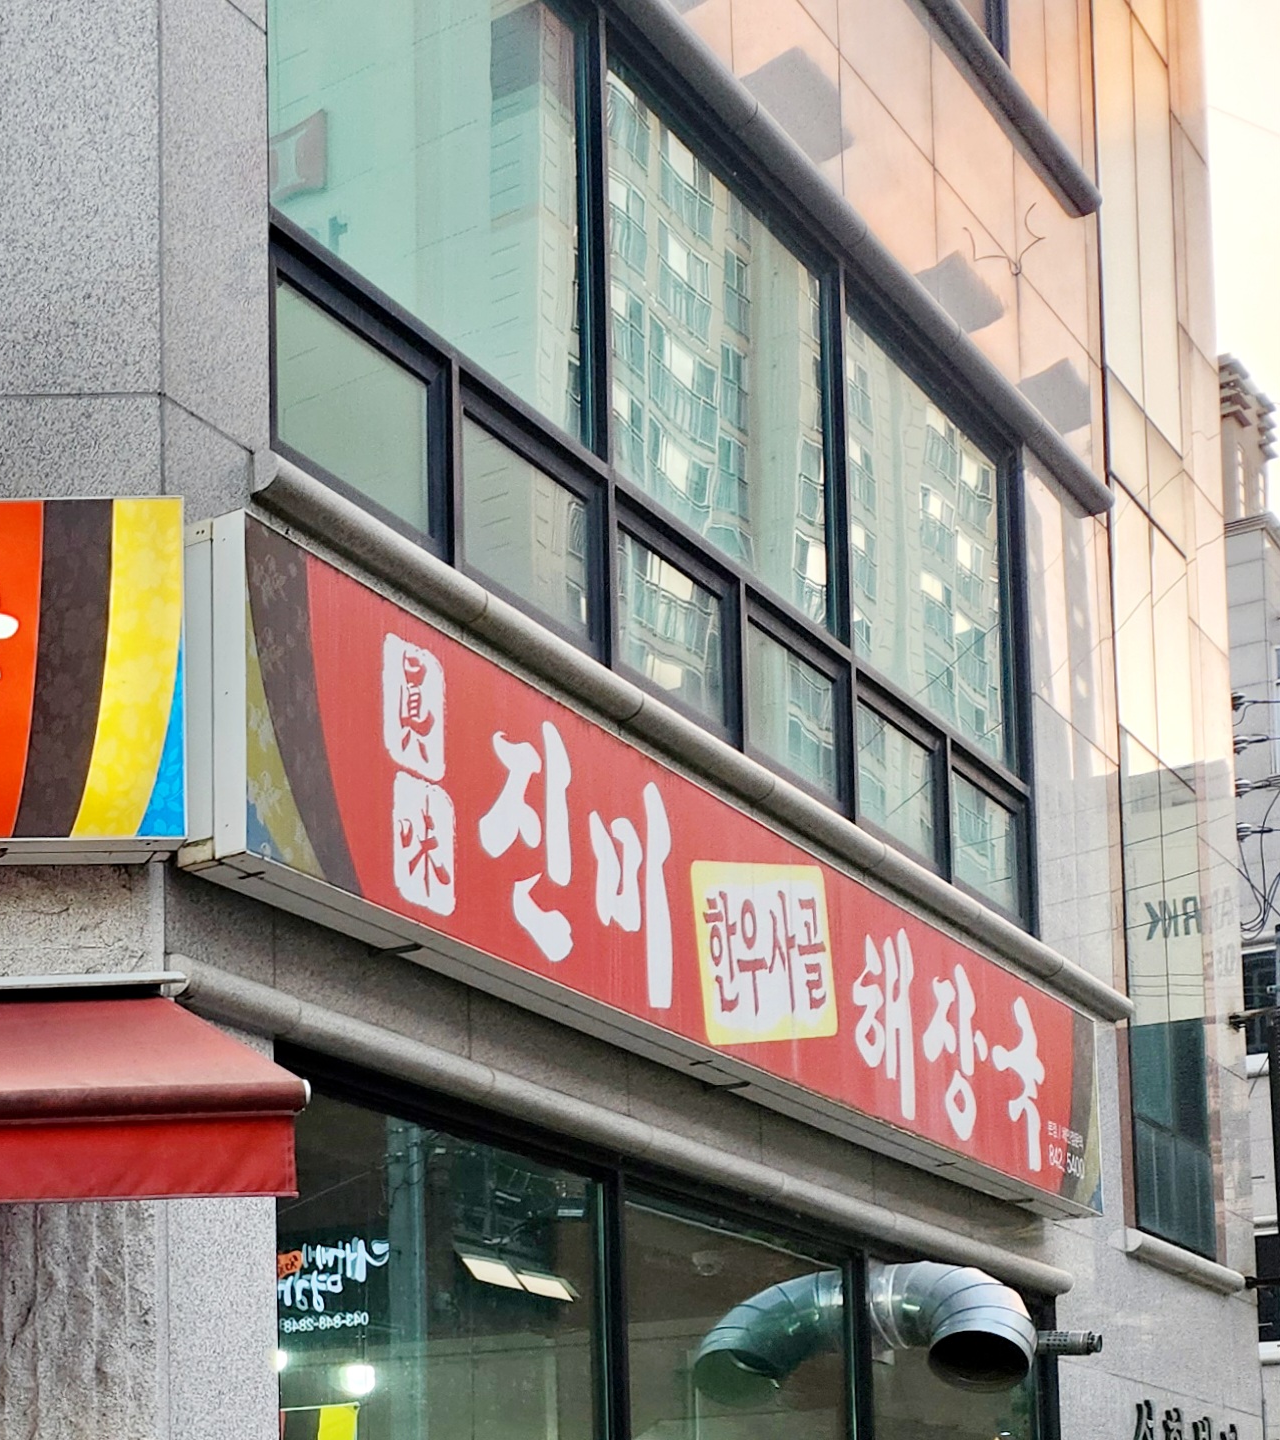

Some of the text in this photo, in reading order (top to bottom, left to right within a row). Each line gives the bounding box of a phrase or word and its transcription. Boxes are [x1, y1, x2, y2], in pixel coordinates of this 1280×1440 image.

[479, 720, 1045, 1172] 진미 한우사골 해장국
